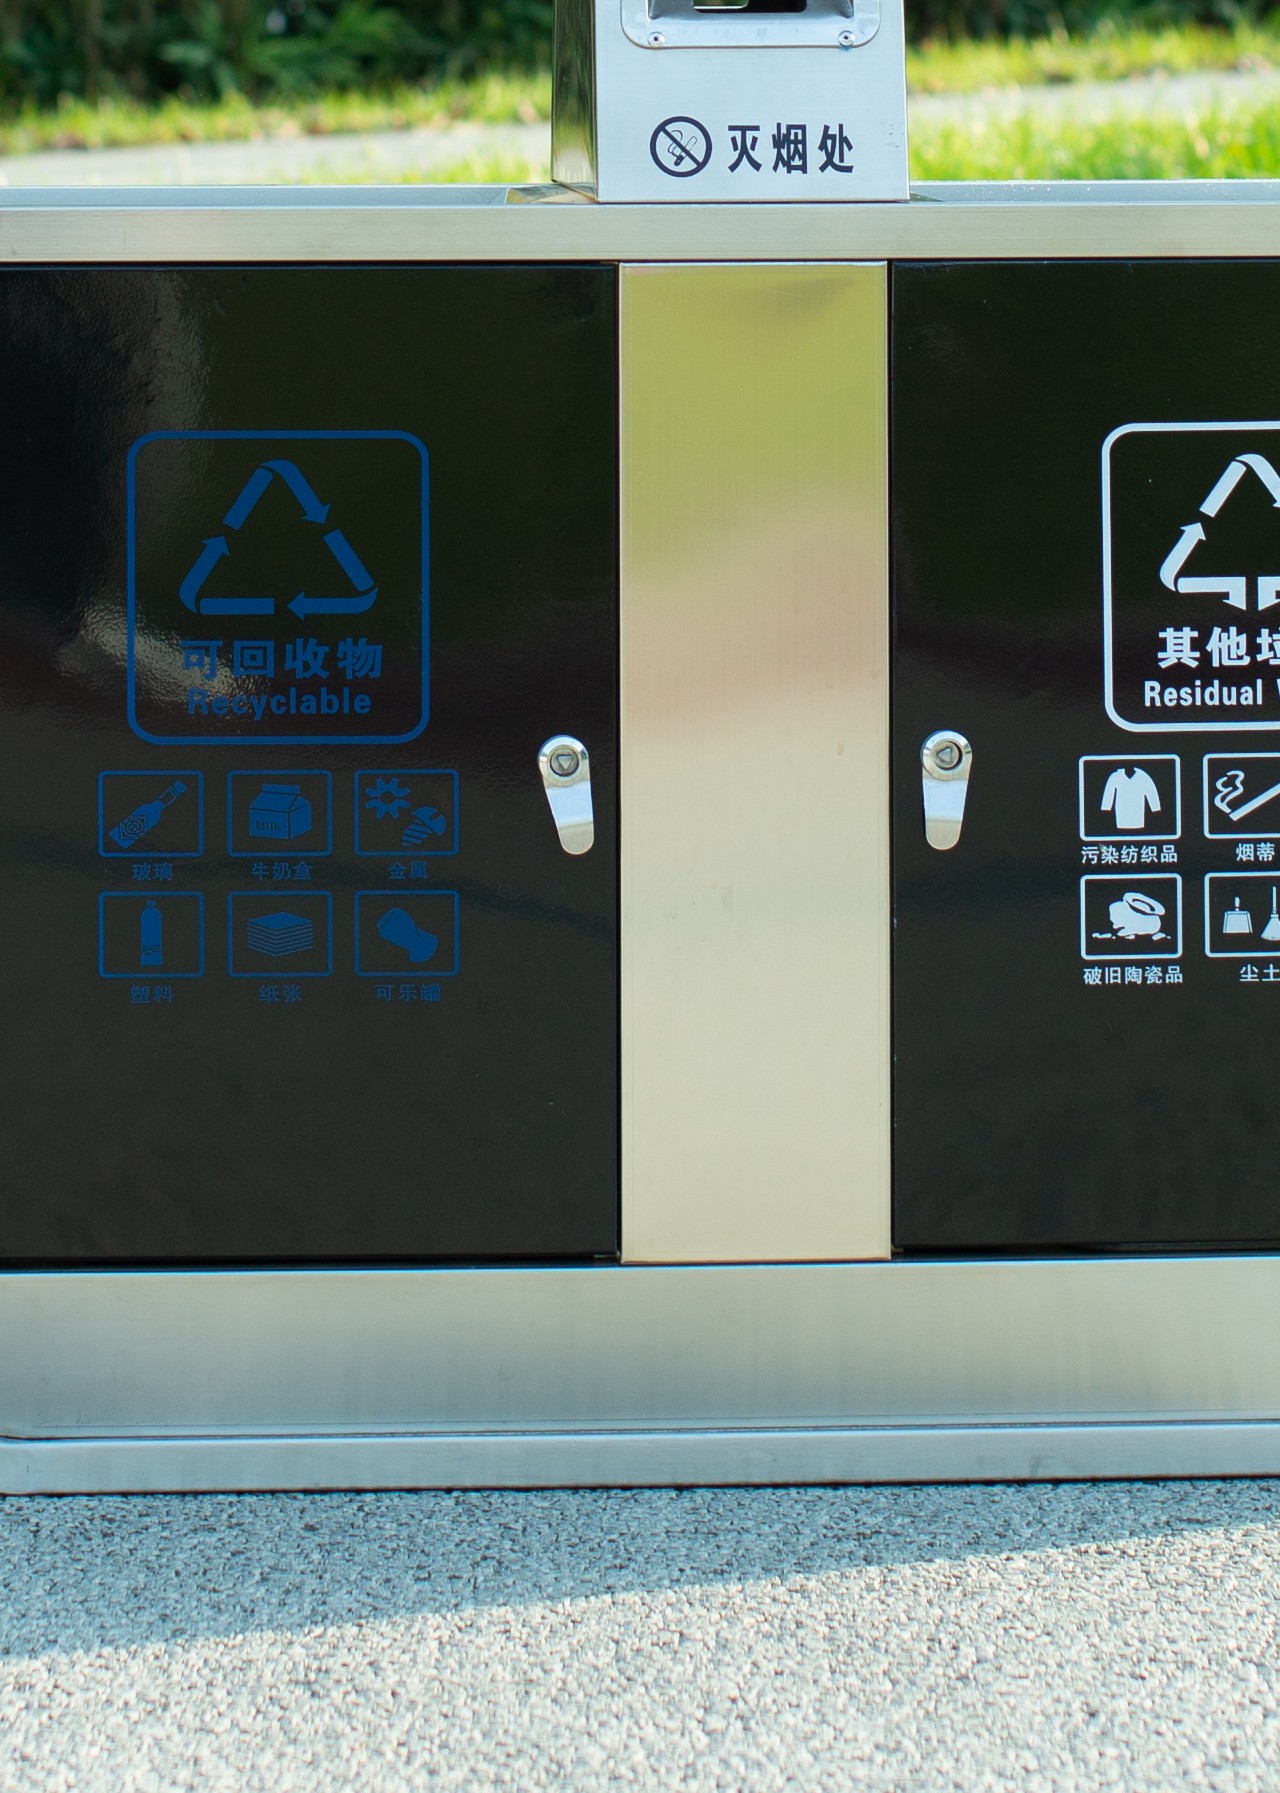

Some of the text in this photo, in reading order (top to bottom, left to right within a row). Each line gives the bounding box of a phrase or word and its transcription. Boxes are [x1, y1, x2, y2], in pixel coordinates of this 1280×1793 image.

[728, 123, 853, 174] 灭烟处
[178, 637, 383, 680] 可回收物
[1144, 679, 1263, 707] Residual
[188, 687, 372, 721] Recyclable
[1081, 845, 1178, 864] 污染纺织品
[1235, 842, 1276, 862] 烟蒂
[132, 862, 173, 881] 玻璃
[251, 861, 312, 881] 牛奶盒
[388, 861, 428, 880] 金属
[1083, 965, 1183, 985] 破旧陶瓷品
[130, 984, 175, 1003] 塑料
[259, 984, 303, 1002] 纸张
[375, 983, 442, 1002] 可乐罐
